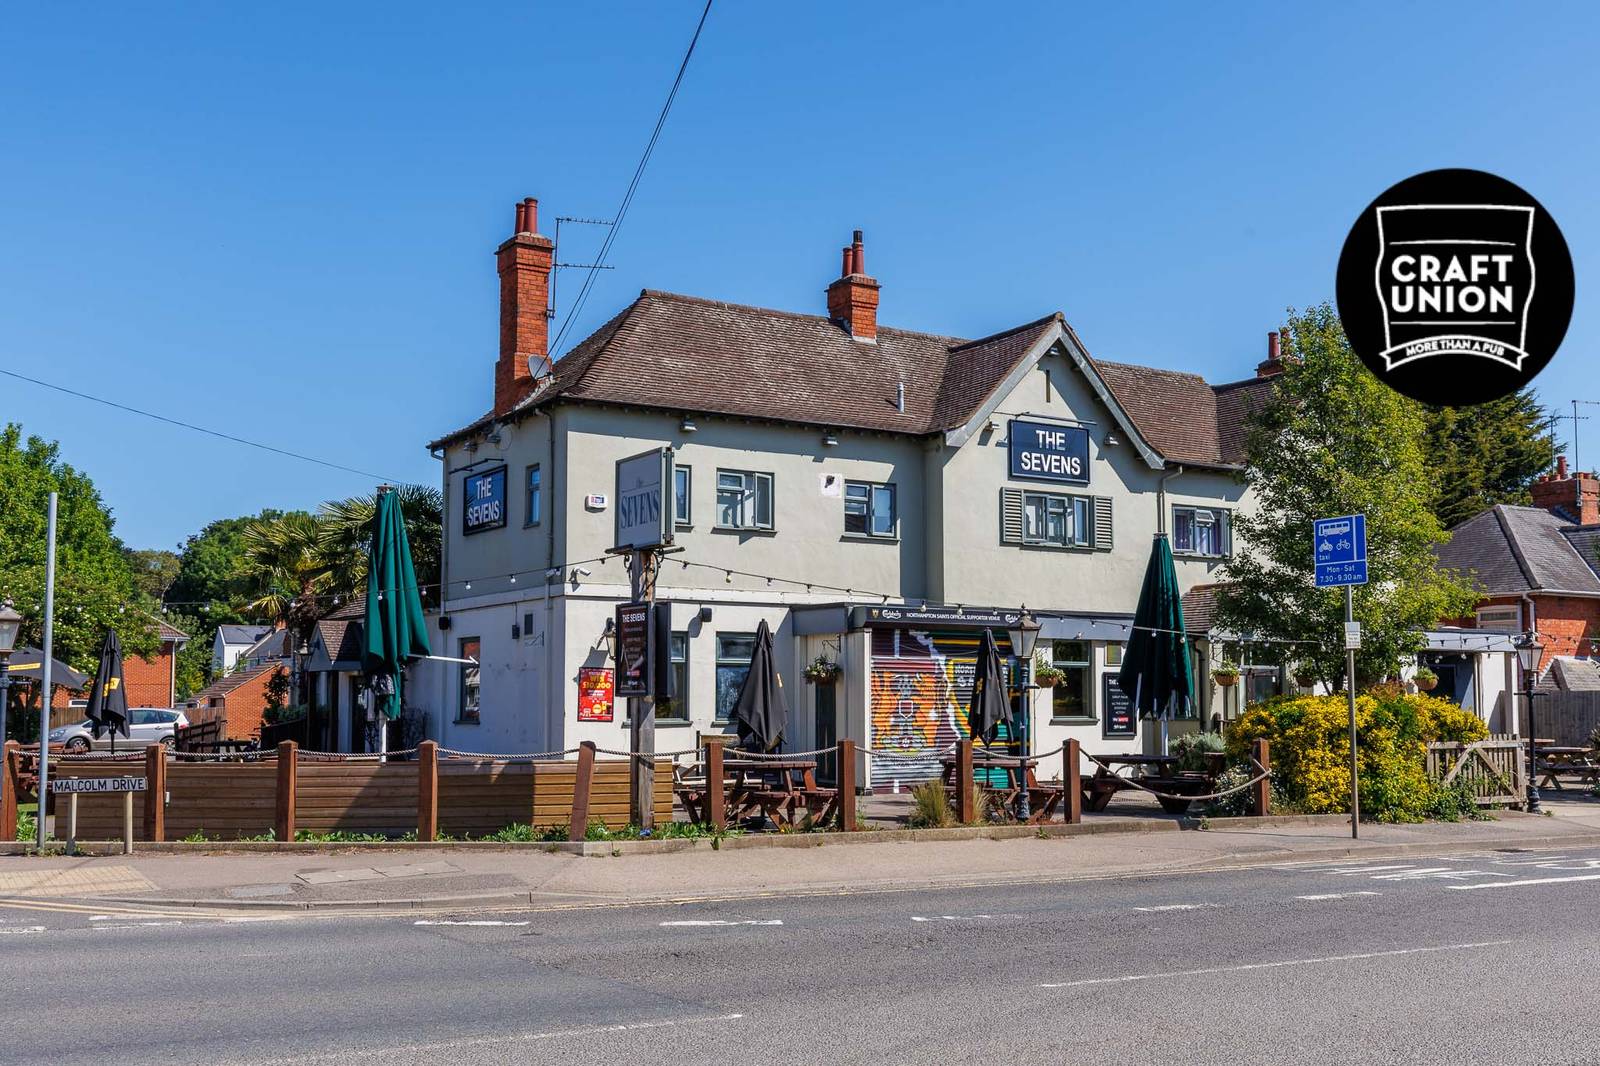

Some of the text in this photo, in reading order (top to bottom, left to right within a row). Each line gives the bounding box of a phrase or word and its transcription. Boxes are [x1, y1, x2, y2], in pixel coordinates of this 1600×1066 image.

[1035, 429, 1066, 451] THE
[1021, 451, 1081, 476] SEVENS
[476, 477, 492, 500] THE
[468, 500, 500, 527] SEVENS
[620, 489, 660, 529] SEVENS
[622, 612, 646, 622] THE SEVENS
[54, 779, 145, 792] MALCOLM DRIVE
